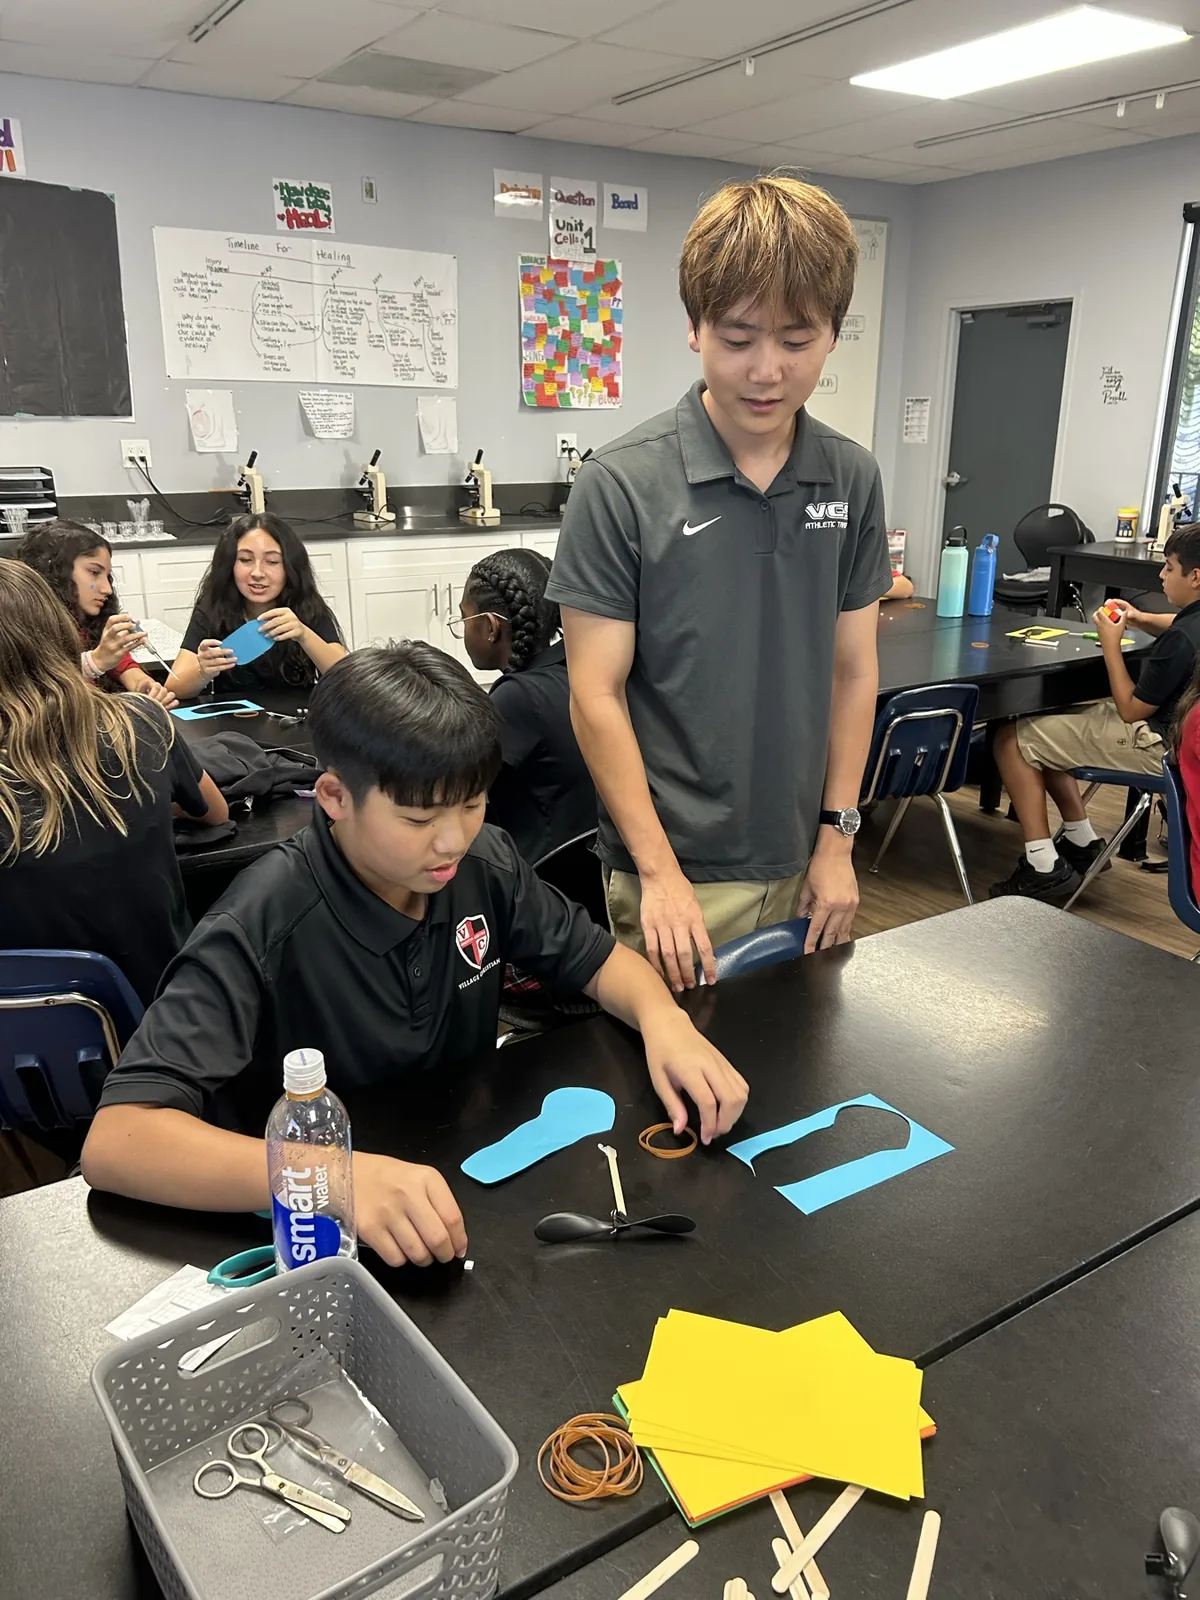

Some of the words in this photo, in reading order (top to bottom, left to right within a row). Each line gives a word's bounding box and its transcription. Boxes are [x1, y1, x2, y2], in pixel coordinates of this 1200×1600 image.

[279, 182, 304, 197] How
[304, 183, 331, 201] does
[554, 190, 596, 207] Question
[611, 193, 639, 211] Board
[554, 233, 579, 245] Cells
[556, 218, 584, 232] Unit
[584, 227, 596, 254] 1
[225, 237, 260, 251] Timeline
[276, 243, 293, 253] For
[316, 248, 352, 268] Healing
[611, 297, 622, 307] PT
[282, 1166, 317, 1262] smart
